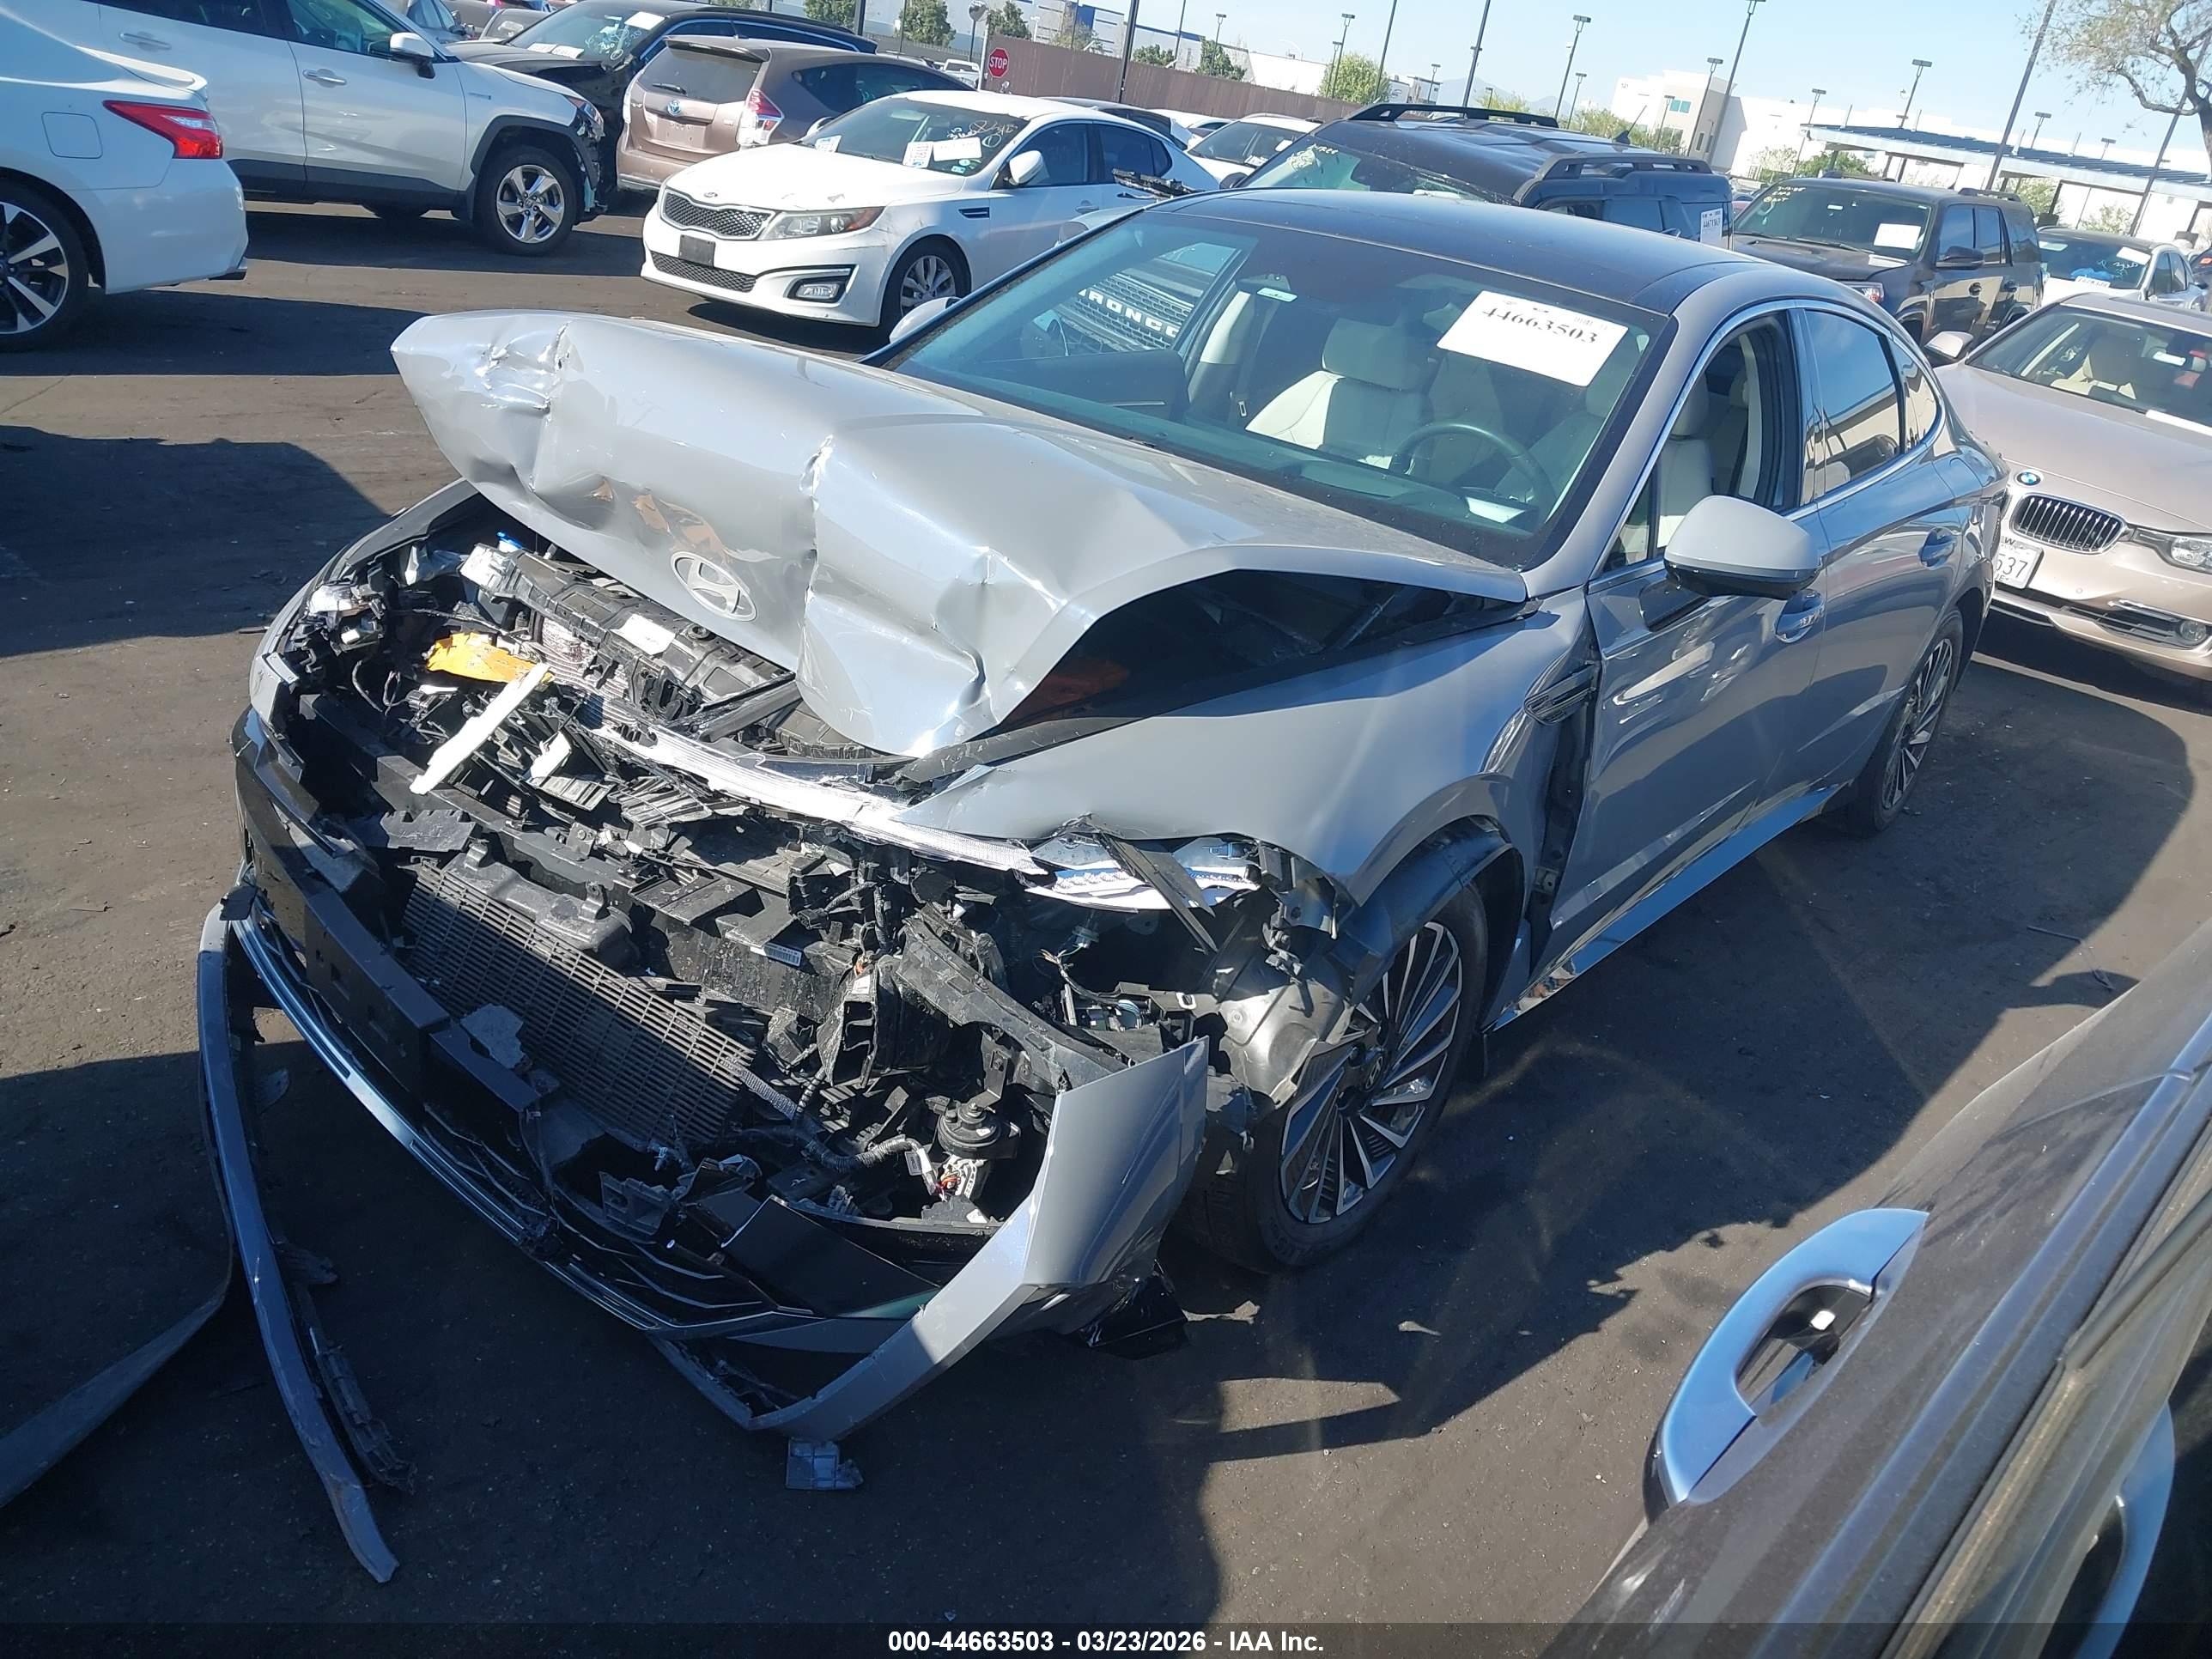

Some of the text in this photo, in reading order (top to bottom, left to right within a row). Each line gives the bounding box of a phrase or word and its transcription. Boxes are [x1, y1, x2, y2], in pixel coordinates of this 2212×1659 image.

[989, 56, 1008, 70] STOP
[1078, 289, 1180, 338] RONCO
[1482, 307, 1598, 343] 44663503
